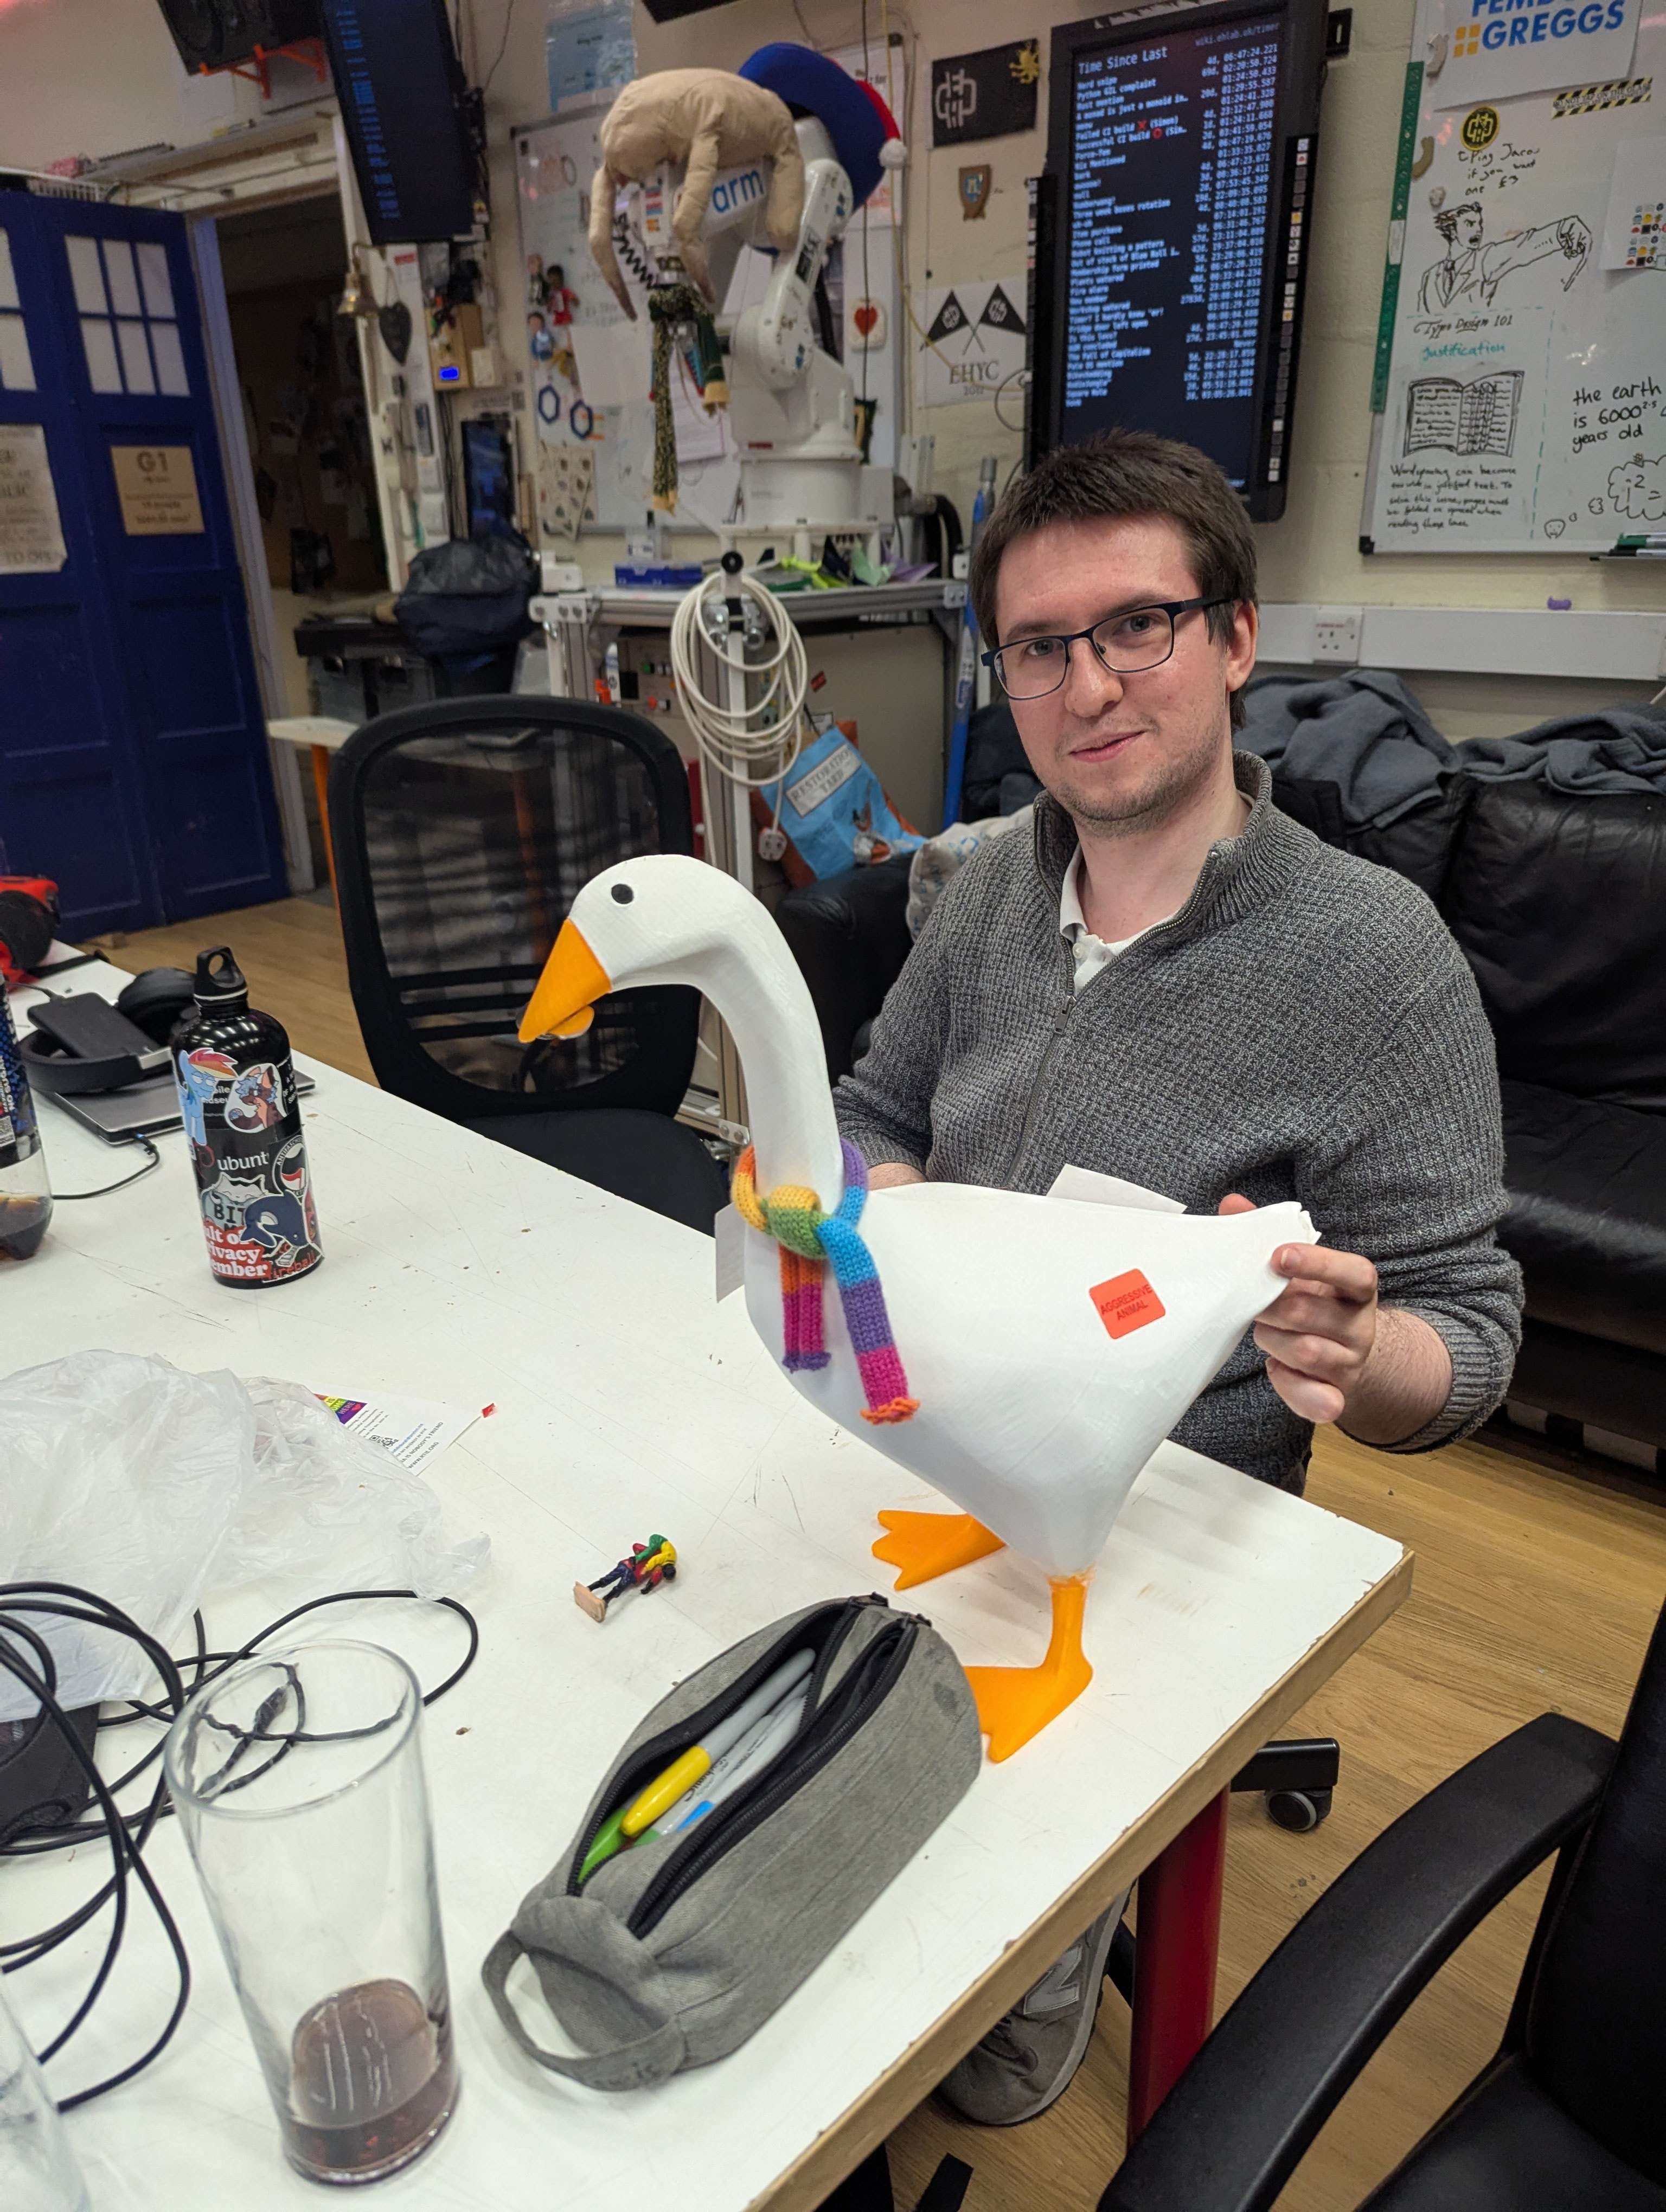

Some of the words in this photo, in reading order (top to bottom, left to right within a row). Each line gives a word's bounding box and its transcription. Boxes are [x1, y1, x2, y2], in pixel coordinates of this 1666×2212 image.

[1482, 1, 1625, 49] GREGGS
[1078, 61, 1103, 74] Time
[1107, 54, 1138, 69] Since
[1142, 47, 1168, 62] Last
[1119, 78, 1156, 93] complaint
[712, 170, 764, 214] arm
[1413, 319, 1452, 339] Type
[1455, 316, 1489, 333] Design
[1494, 315, 1513, 326] 101
[950, 359, 999, 385] EHYC
[1573, 387, 1601, 406] the
[1612, 376, 1662, 400] earth
[1574, 412, 1587, 428] is
[1573, 431, 1608, 454] years
[1618, 423, 1643, 440] old
[137, 451, 168, 473] G1
[1480, 464, 1517, 475] become
[218, 1151, 270, 1171] ubunt
[204, 1226, 223, 1244] ult
[210, 1261, 268, 1277] ember
[1100, 1284, 1154, 1315] AGGRESSIVE
[1116, 1300, 1149, 1321] ANIMAL
[337, 1401, 356, 1414] HERE
[409, 1436, 431, 1456] NOBODY'S
[428, 1422, 444, 1439] FRIEND
